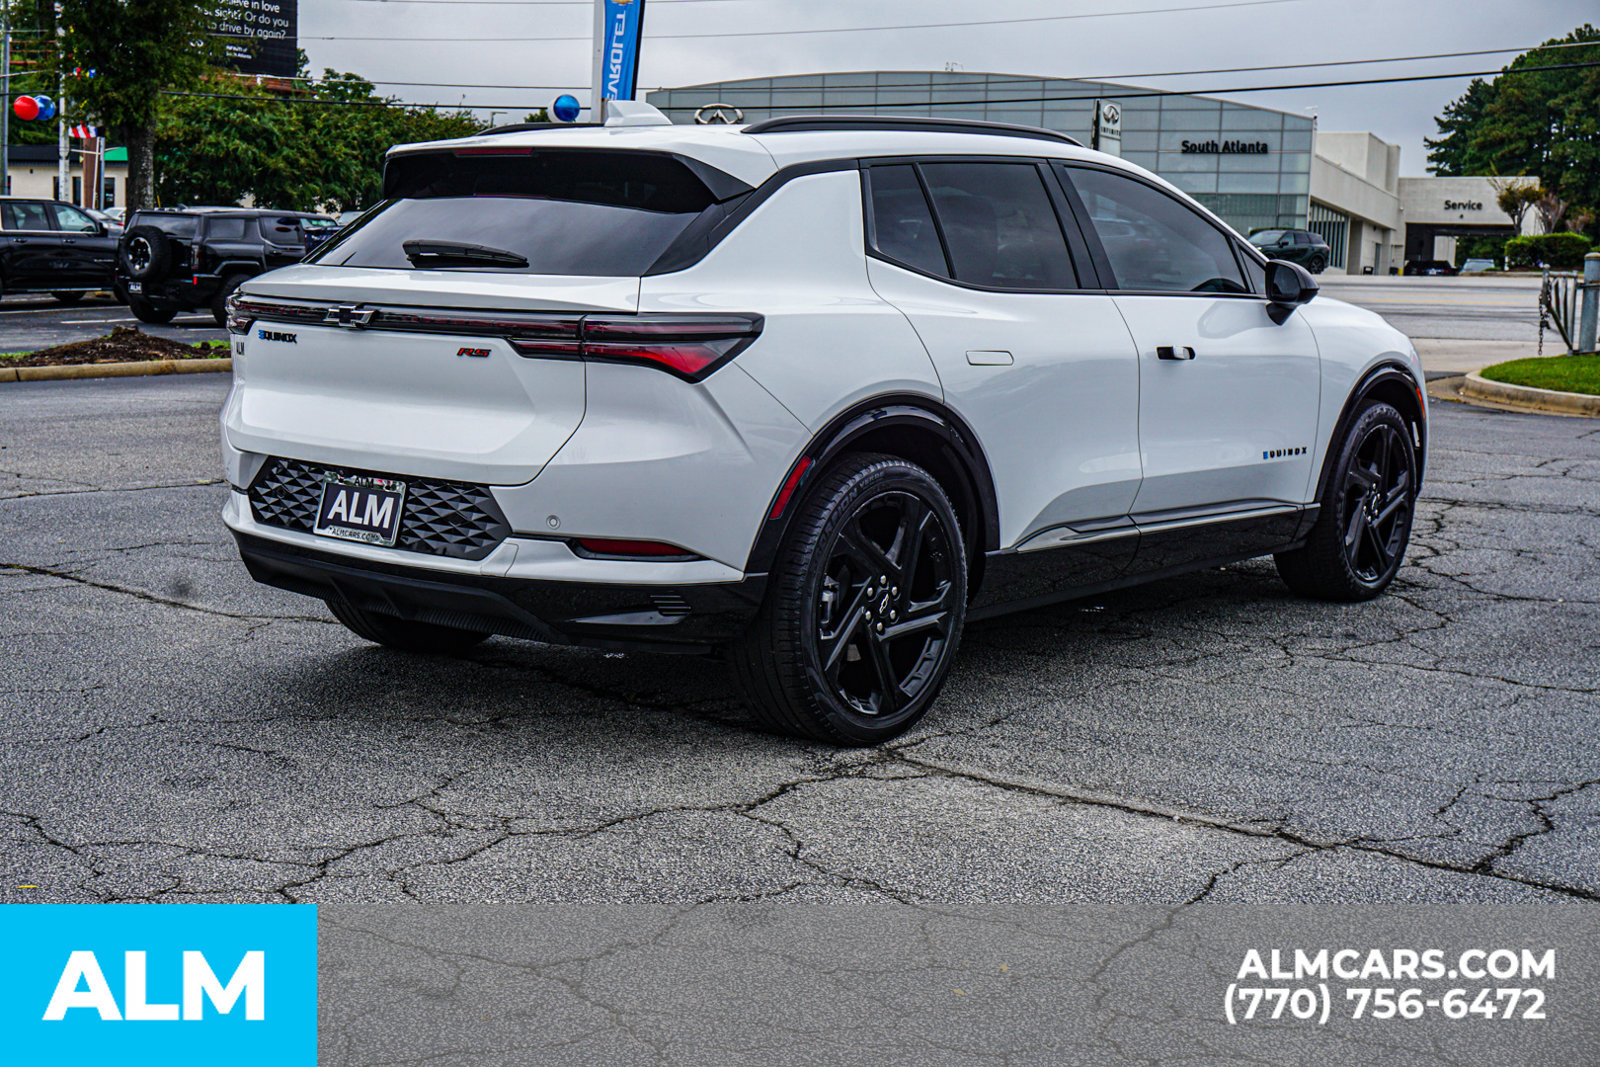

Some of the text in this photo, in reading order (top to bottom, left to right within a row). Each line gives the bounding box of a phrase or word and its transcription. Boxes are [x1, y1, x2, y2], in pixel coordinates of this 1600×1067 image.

[251, 0, 260, 9] in
[261, 0, 280, 13] love
[245, 11, 256, 22] Or
[258, 14, 270, 25] do
[272, 17, 289, 28] you
[219, 22, 242, 33] drive
[243, 24, 255, 37] by
[256, 29, 286, 40] again?
[1181, 140, 1269, 154] South Atlanta
[1444, 199, 1483, 211] Service
[258, 329, 298, 344] EQUINOX
[457, 347, 492, 358] RS
[1262, 446, 1307, 460] EQUINOX
[327, 489, 395, 529] ALM
